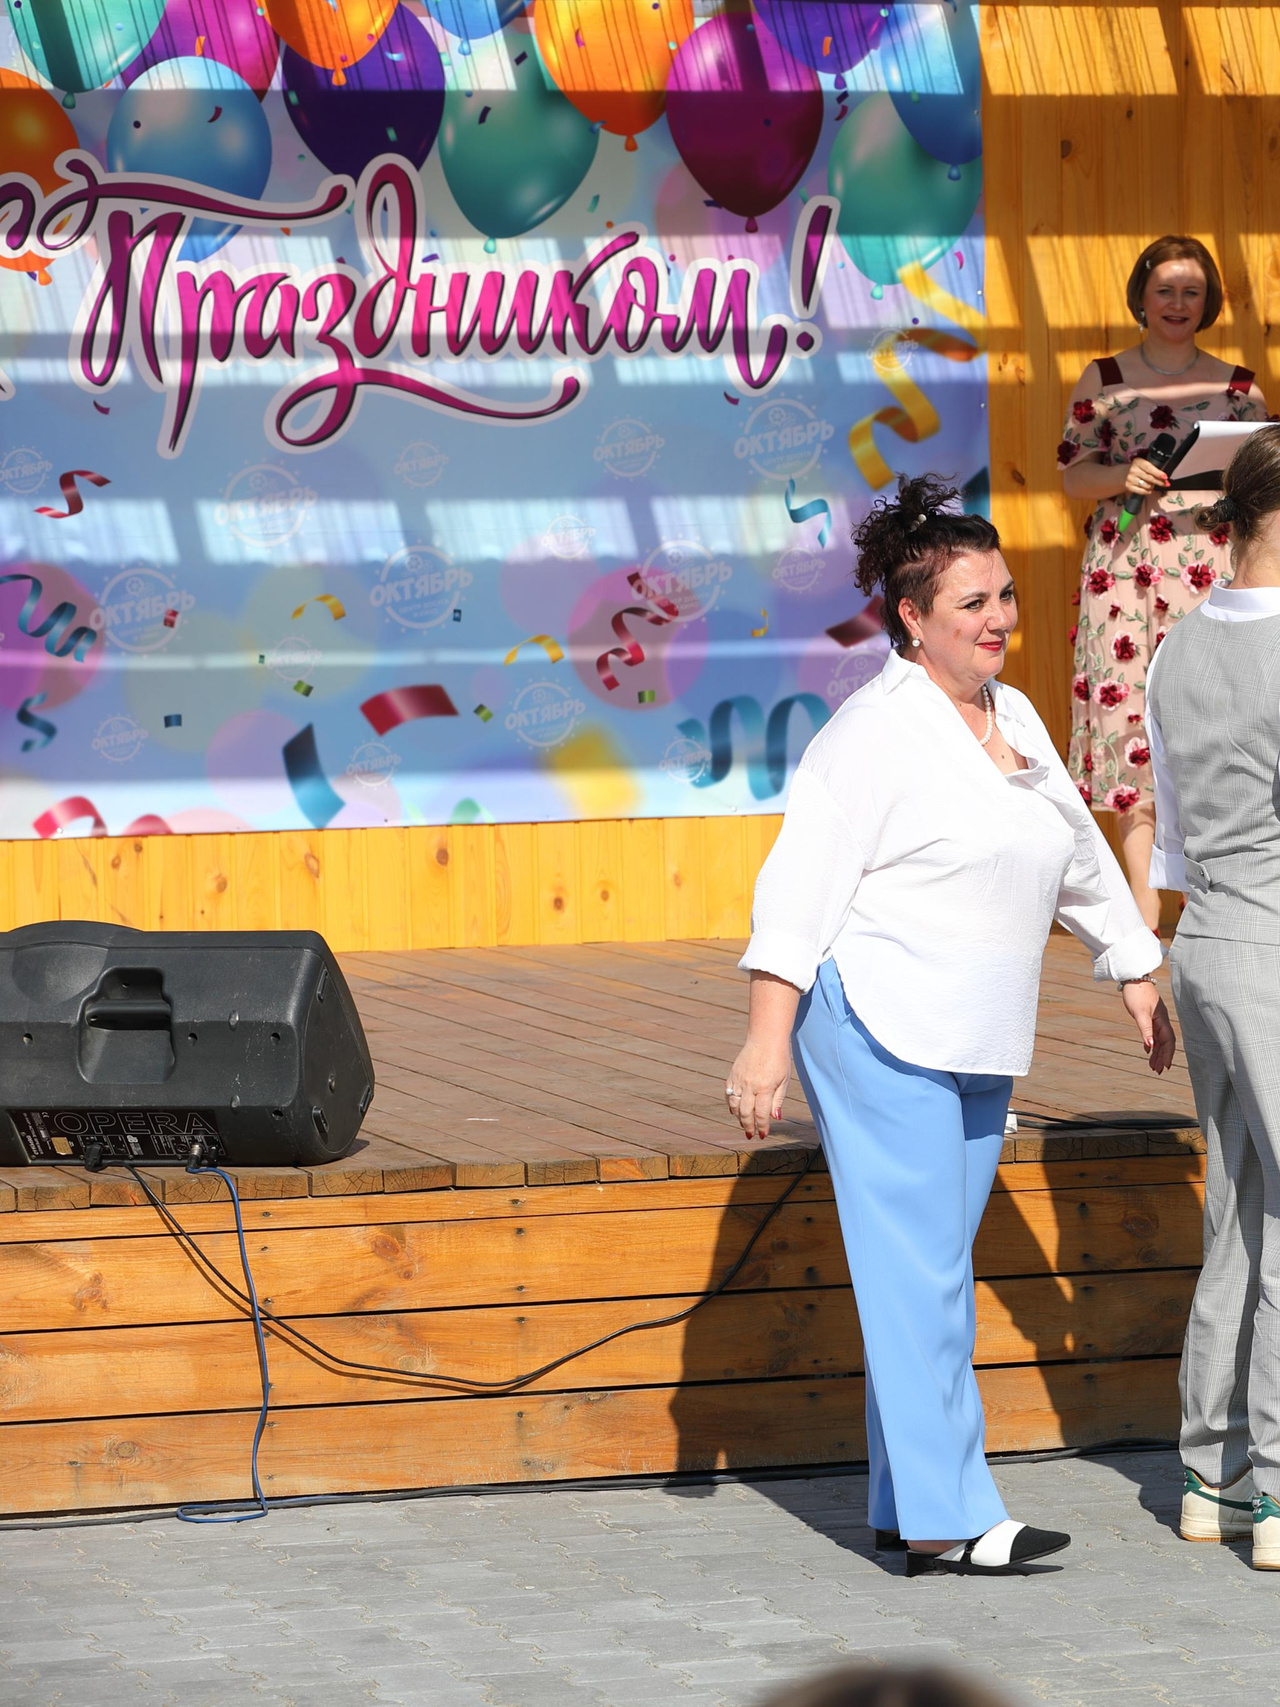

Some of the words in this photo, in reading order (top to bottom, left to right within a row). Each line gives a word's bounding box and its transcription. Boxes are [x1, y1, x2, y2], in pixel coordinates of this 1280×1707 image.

[81, 163, 832, 451] Праздником!
[594, 434, 665, 461] ОКТЯБРЬ
[734, 420, 834, 459] ОКТЯБРЬ
[394, 454, 450, 475] ОКТЯБРЬ
[214, 487, 317, 524] ОКТЯБРЬ
[542, 526, 596, 547] ОКТЯБРЬ
[632, 562, 733, 600] ОКТЯБРЬ
[773, 558, 826, 580] ОКТЯБРЬ
[370, 567, 473, 606] ОКТЯБРЬ
[90, 590, 195, 630] ОКТЯБРЬ
[267, 649, 322, 669] ОКТЯБРЬ
[505, 699, 585, 729] ОКТЯБРЬ
[92, 728, 149, 750] ОКТЯБРЬ
[347, 754, 401, 776] ОКТЯБРЬ
[660, 749, 713, 771] ОКТЯБРЬ
[54, 1112, 217, 1135] OPERA
